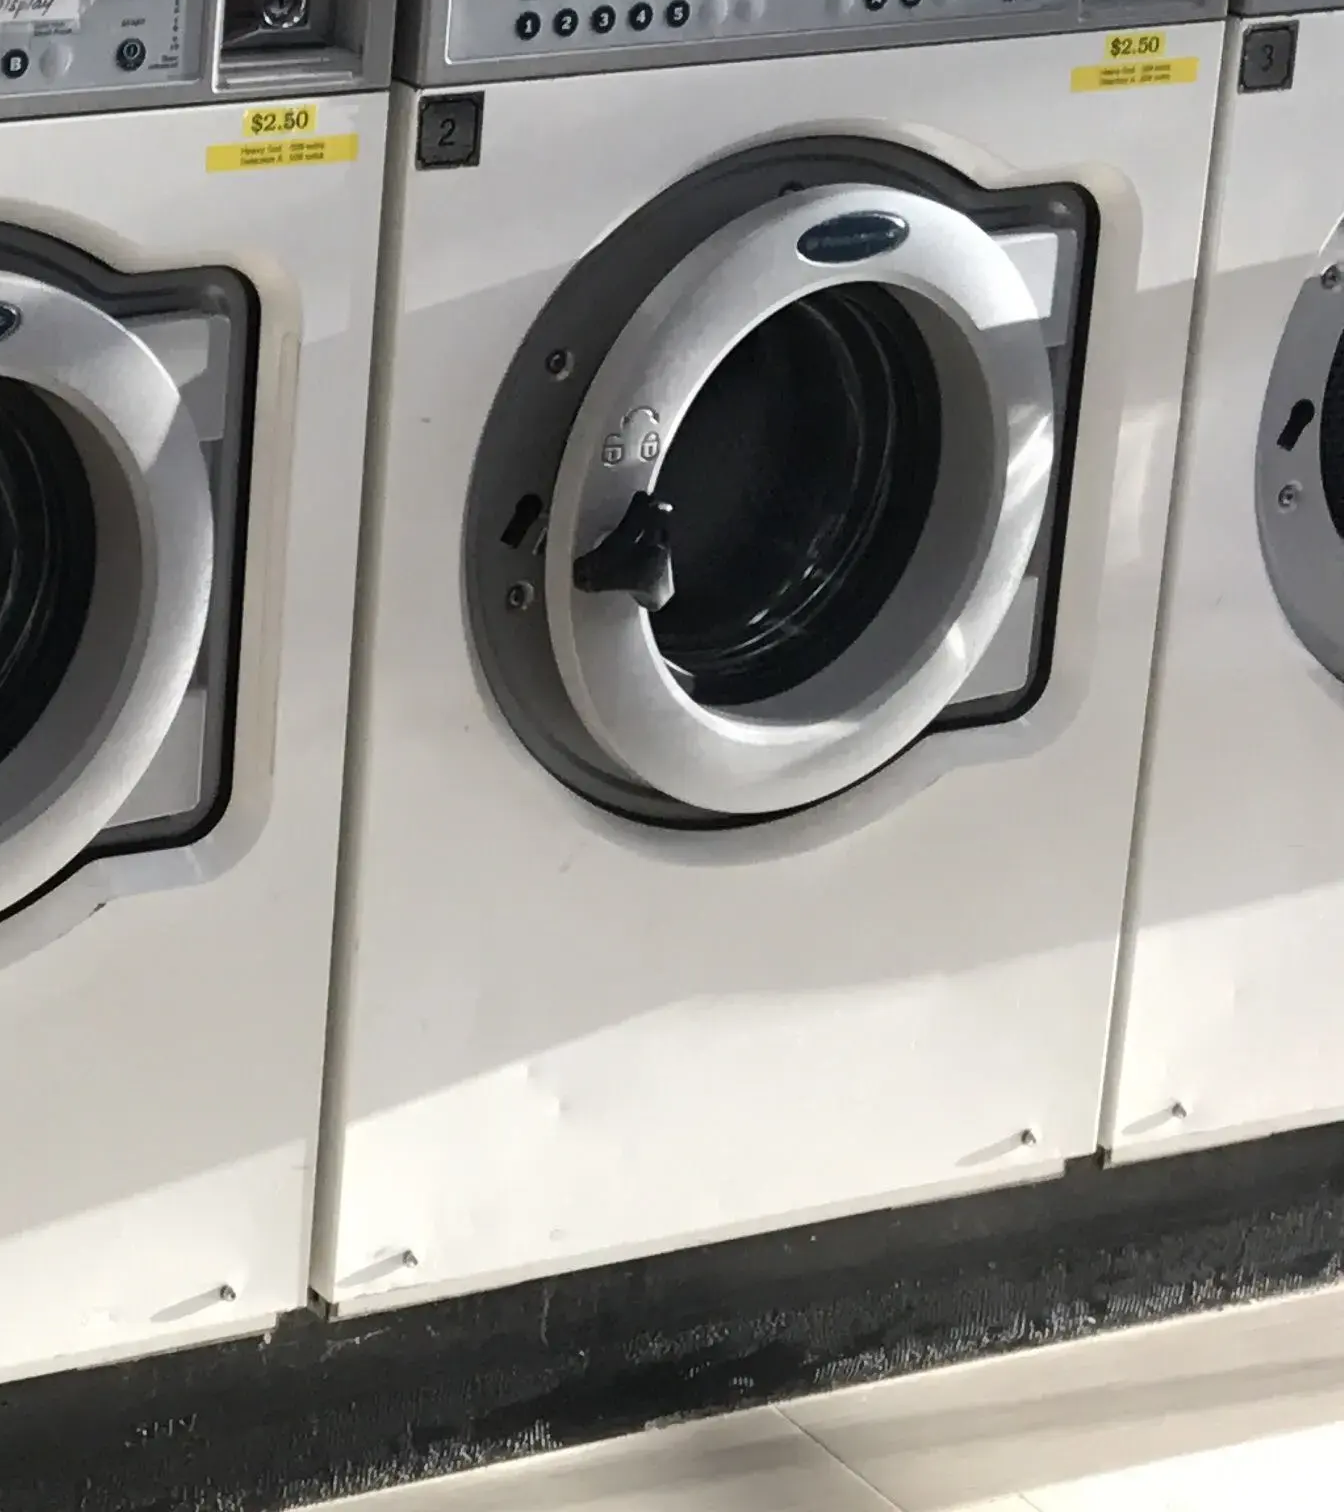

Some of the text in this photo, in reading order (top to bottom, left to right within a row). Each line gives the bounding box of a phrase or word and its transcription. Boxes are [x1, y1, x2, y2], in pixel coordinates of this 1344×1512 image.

[524, 6, 684, 33] 1 2 3 4 5
[1110, 35, 1160, 58] $2.50
[1263, 43, 1275, 72] 3
[9, 56, 22, 72] B
[251, 109, 309, 134] $2.50
[438, 117, 457, 147] 2
